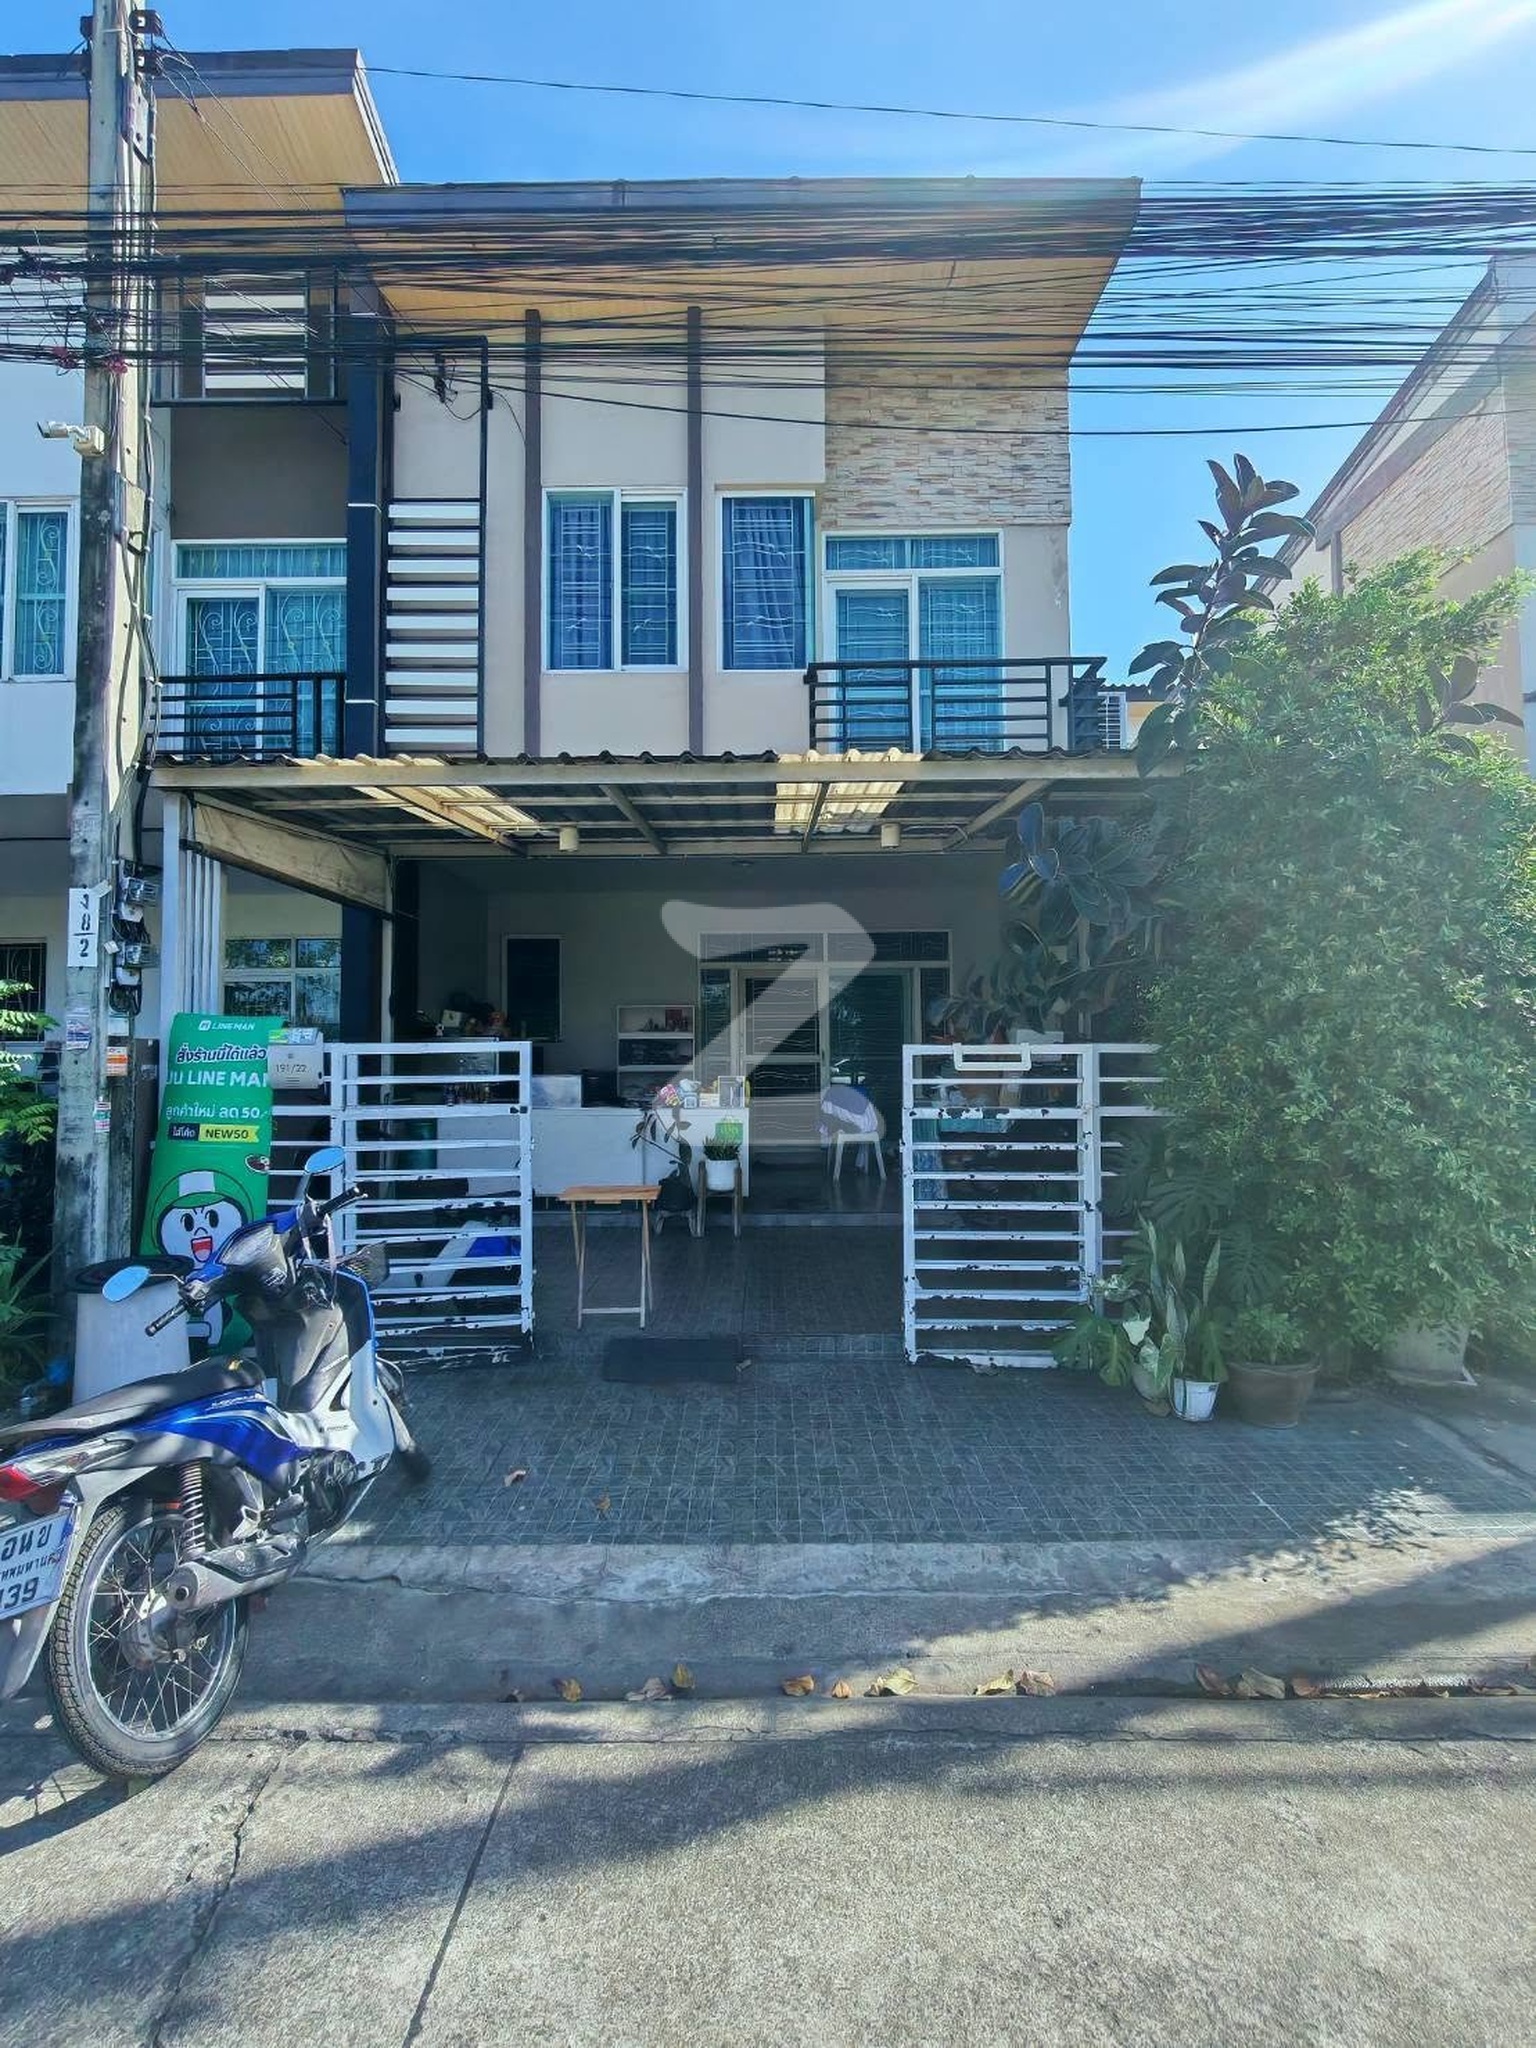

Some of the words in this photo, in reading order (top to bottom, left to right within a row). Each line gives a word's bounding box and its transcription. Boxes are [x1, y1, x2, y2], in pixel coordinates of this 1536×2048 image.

[79, 938, 89, 957] 2
[187, 1070, 226, 1086] LINE
[205, 1129, 250, 1140] NEW50
